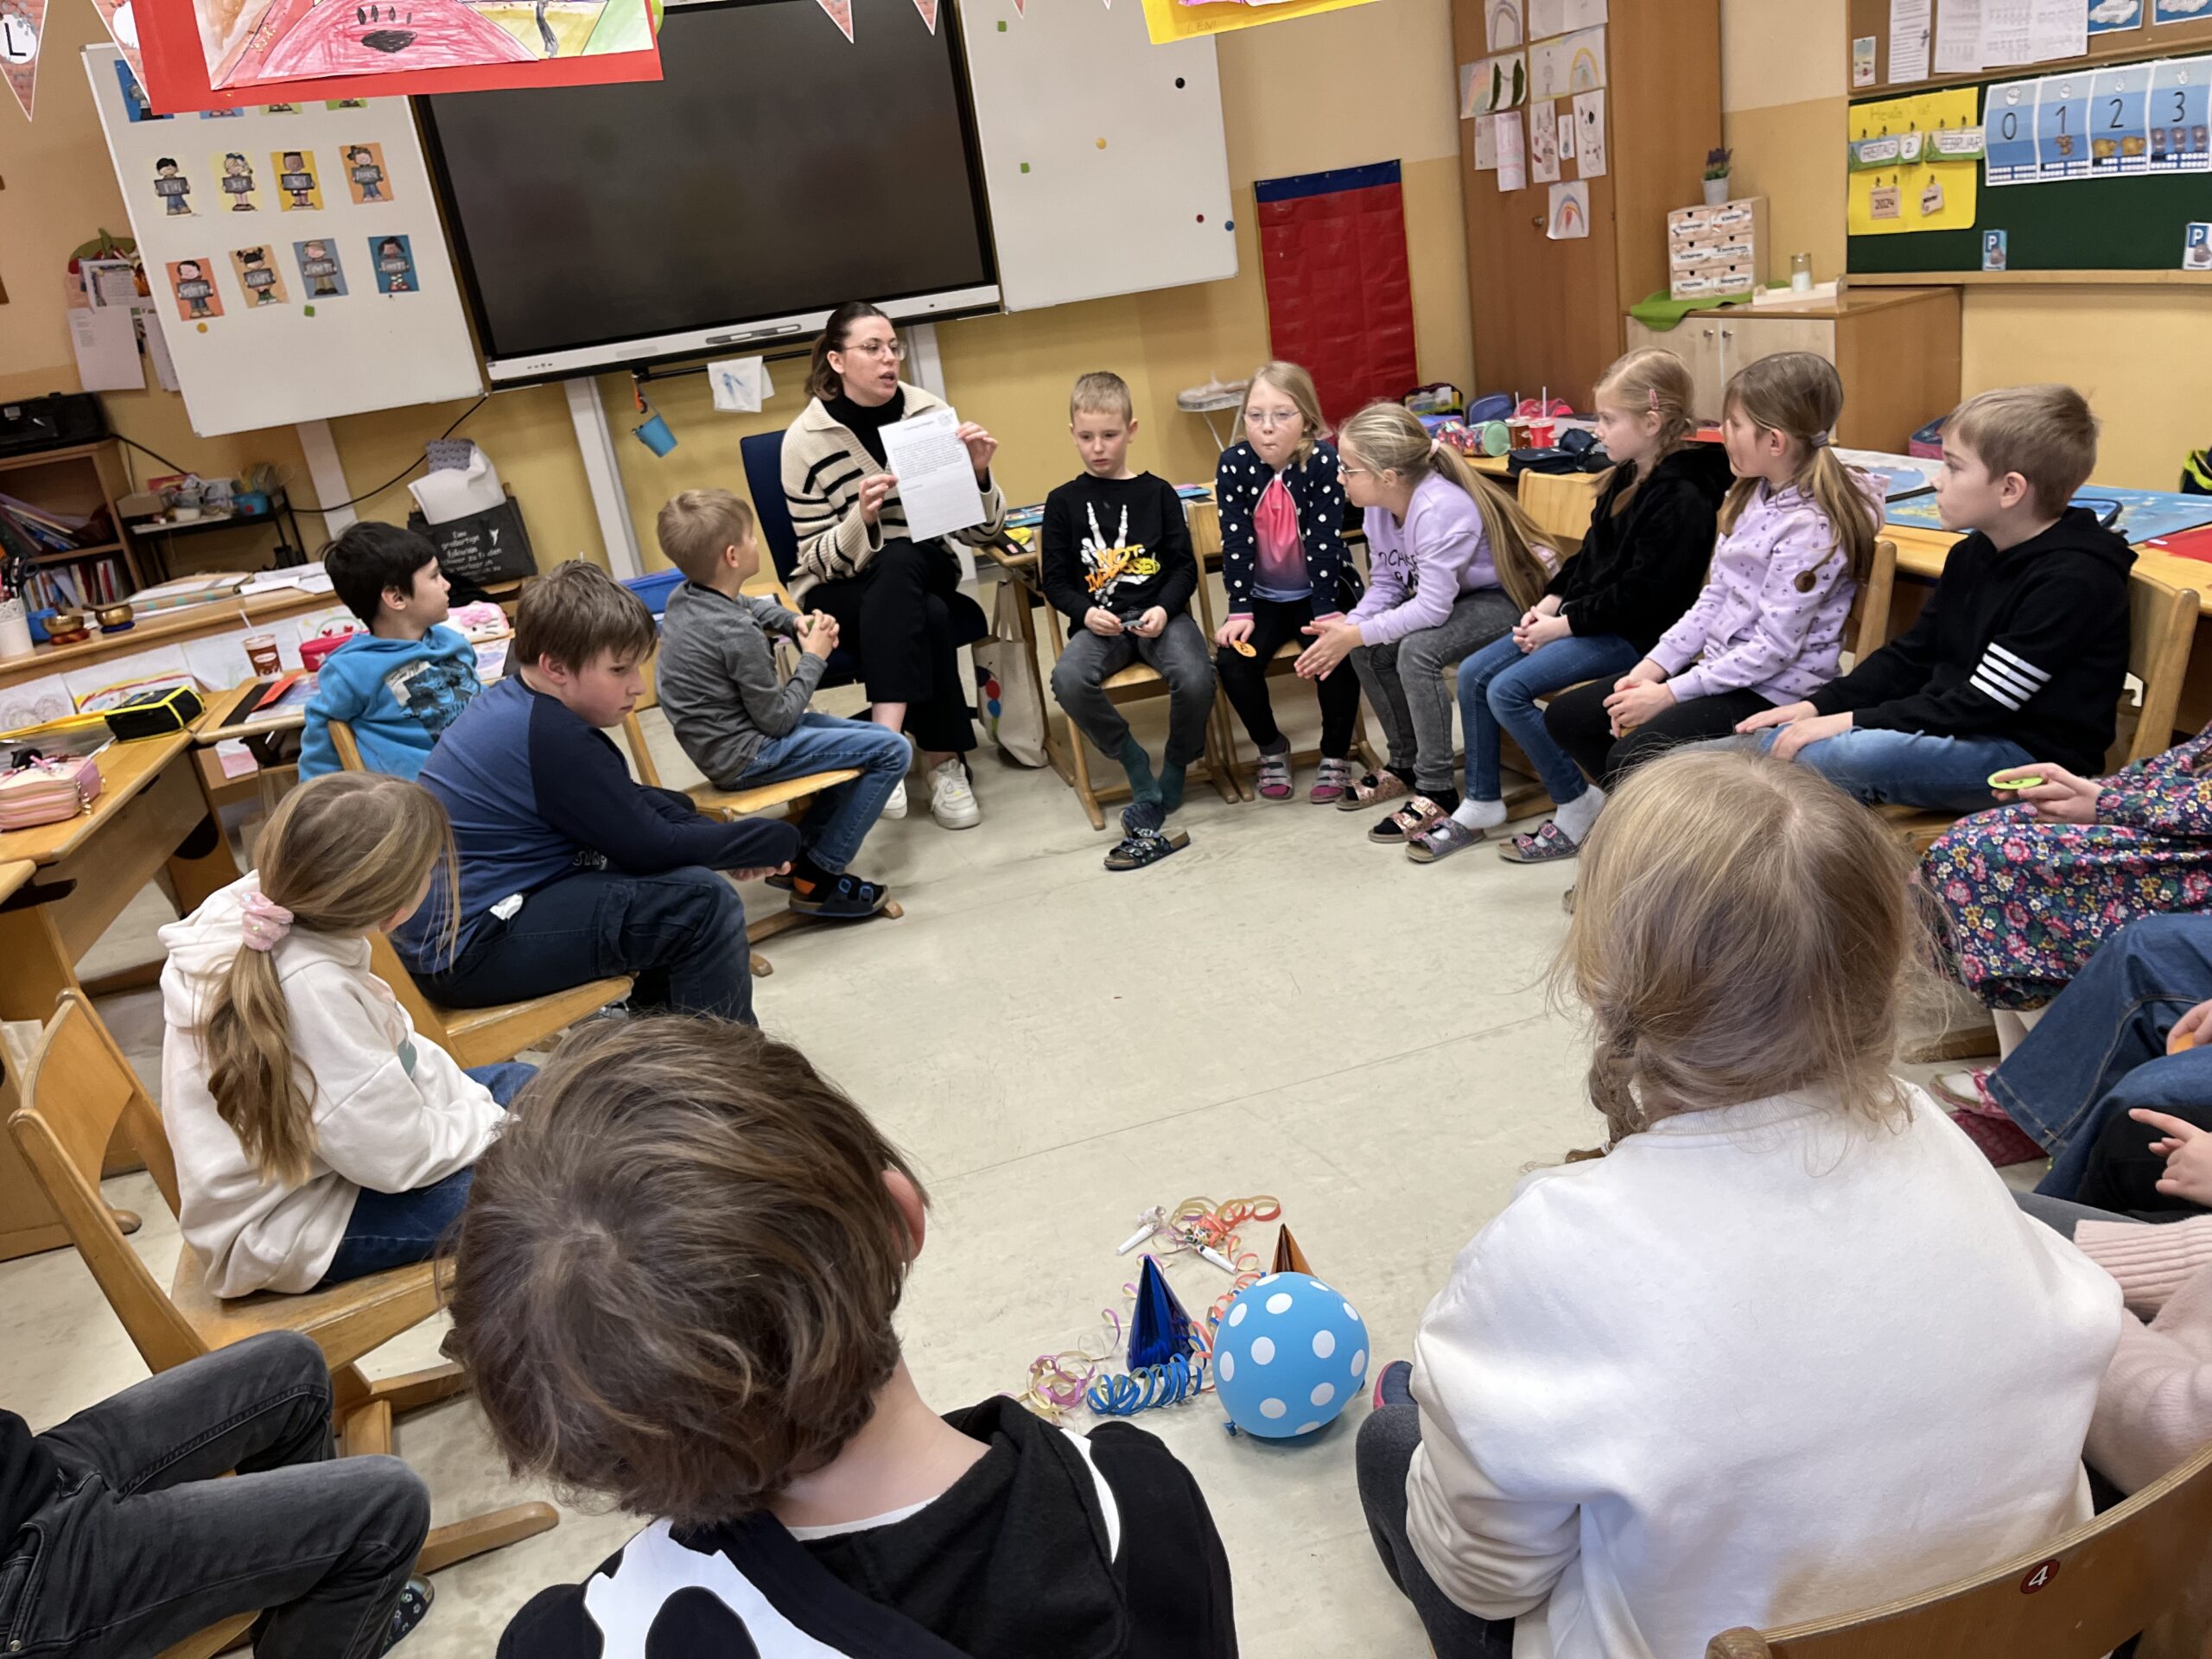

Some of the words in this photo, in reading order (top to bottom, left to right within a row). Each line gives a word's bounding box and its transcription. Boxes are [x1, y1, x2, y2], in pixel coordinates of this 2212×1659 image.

[4, 22, 27, 56] L
[2055, 105, 2067, 134] 1
[2109, 99, 2124, 129] 2
[2171, 91, 2185, 123] 3
[2002, 112, 2017, 140] 0
[1875, 198, 1895, 210] 2024
[1096, 543, 1144, 569] NOT
[2027, 1564, 2049, 1586] 4
